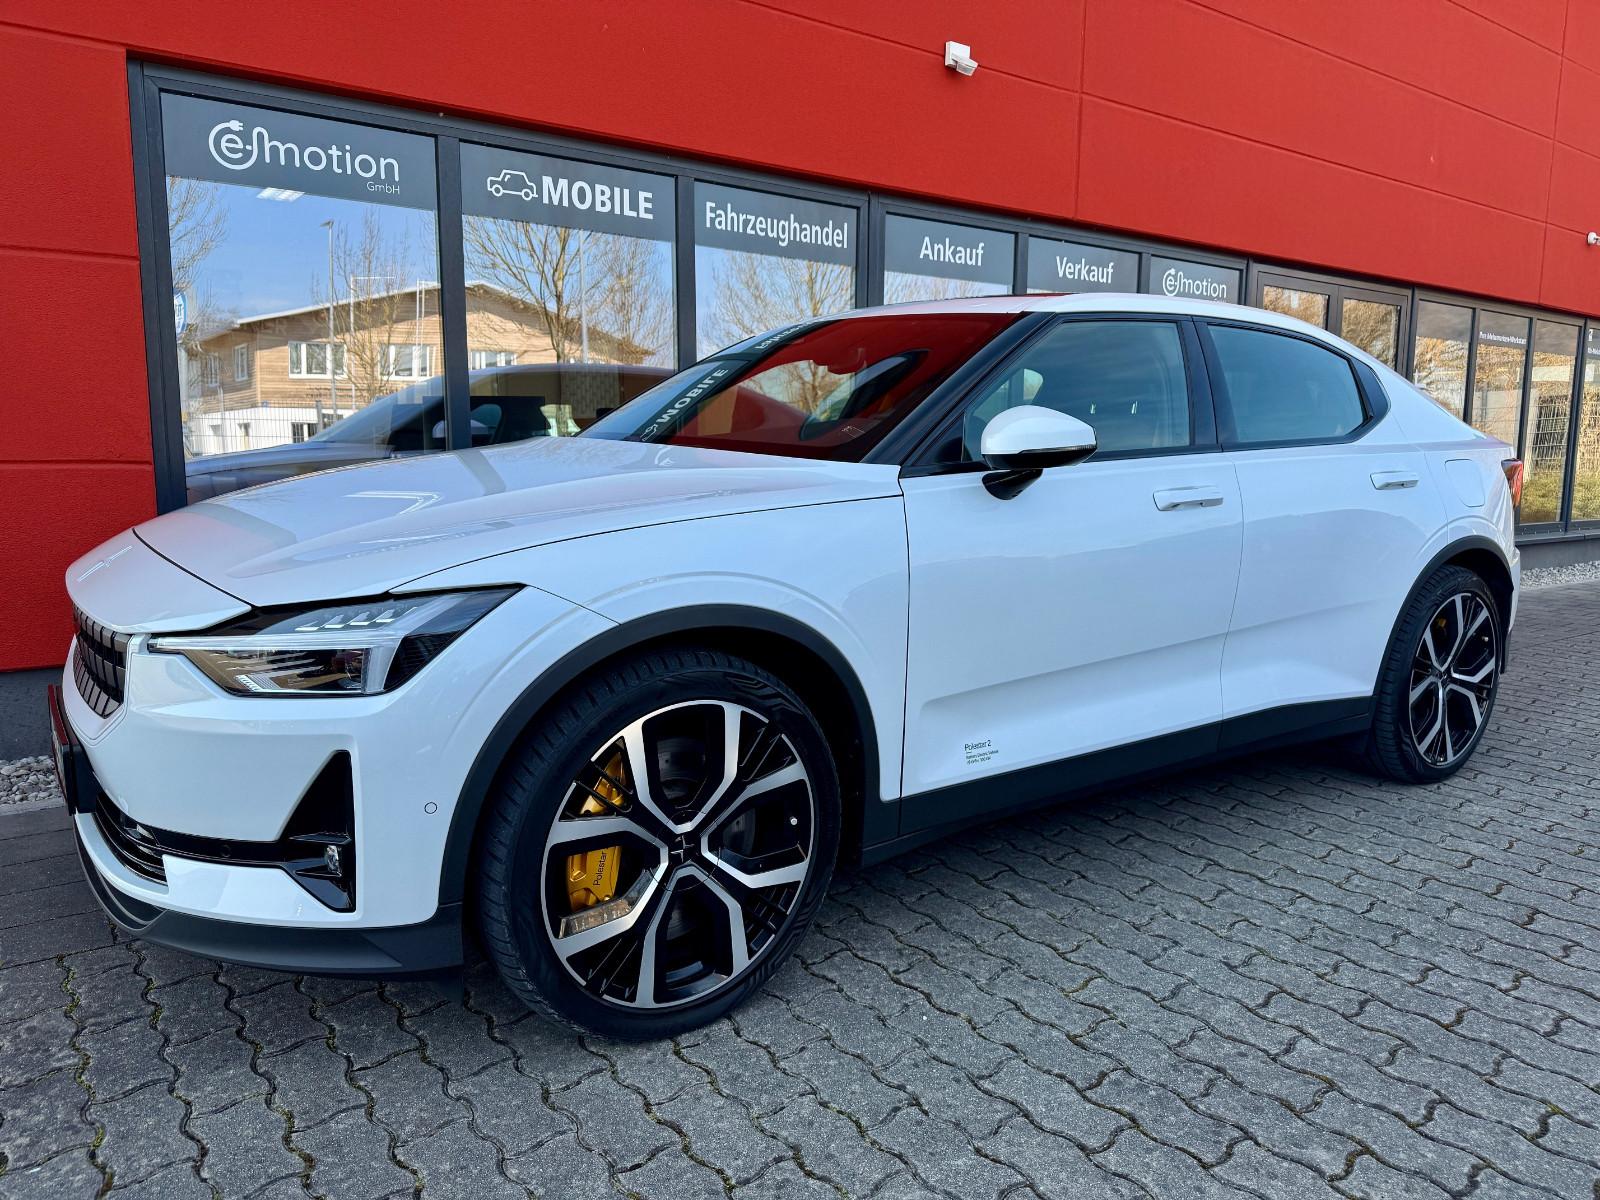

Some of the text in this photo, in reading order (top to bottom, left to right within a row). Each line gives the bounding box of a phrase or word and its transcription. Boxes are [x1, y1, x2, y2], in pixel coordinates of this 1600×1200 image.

[366, 181, 401, 195] GmbH
[541, 176, 655, 221] MOBILE
[705, 201, 849, 250] Fahrzeughandel
[919, 236, 986, 269] Ankauf
[1055, 256, 1115, 286] Verkauf
[593, 851, 608, 886] Polestar
